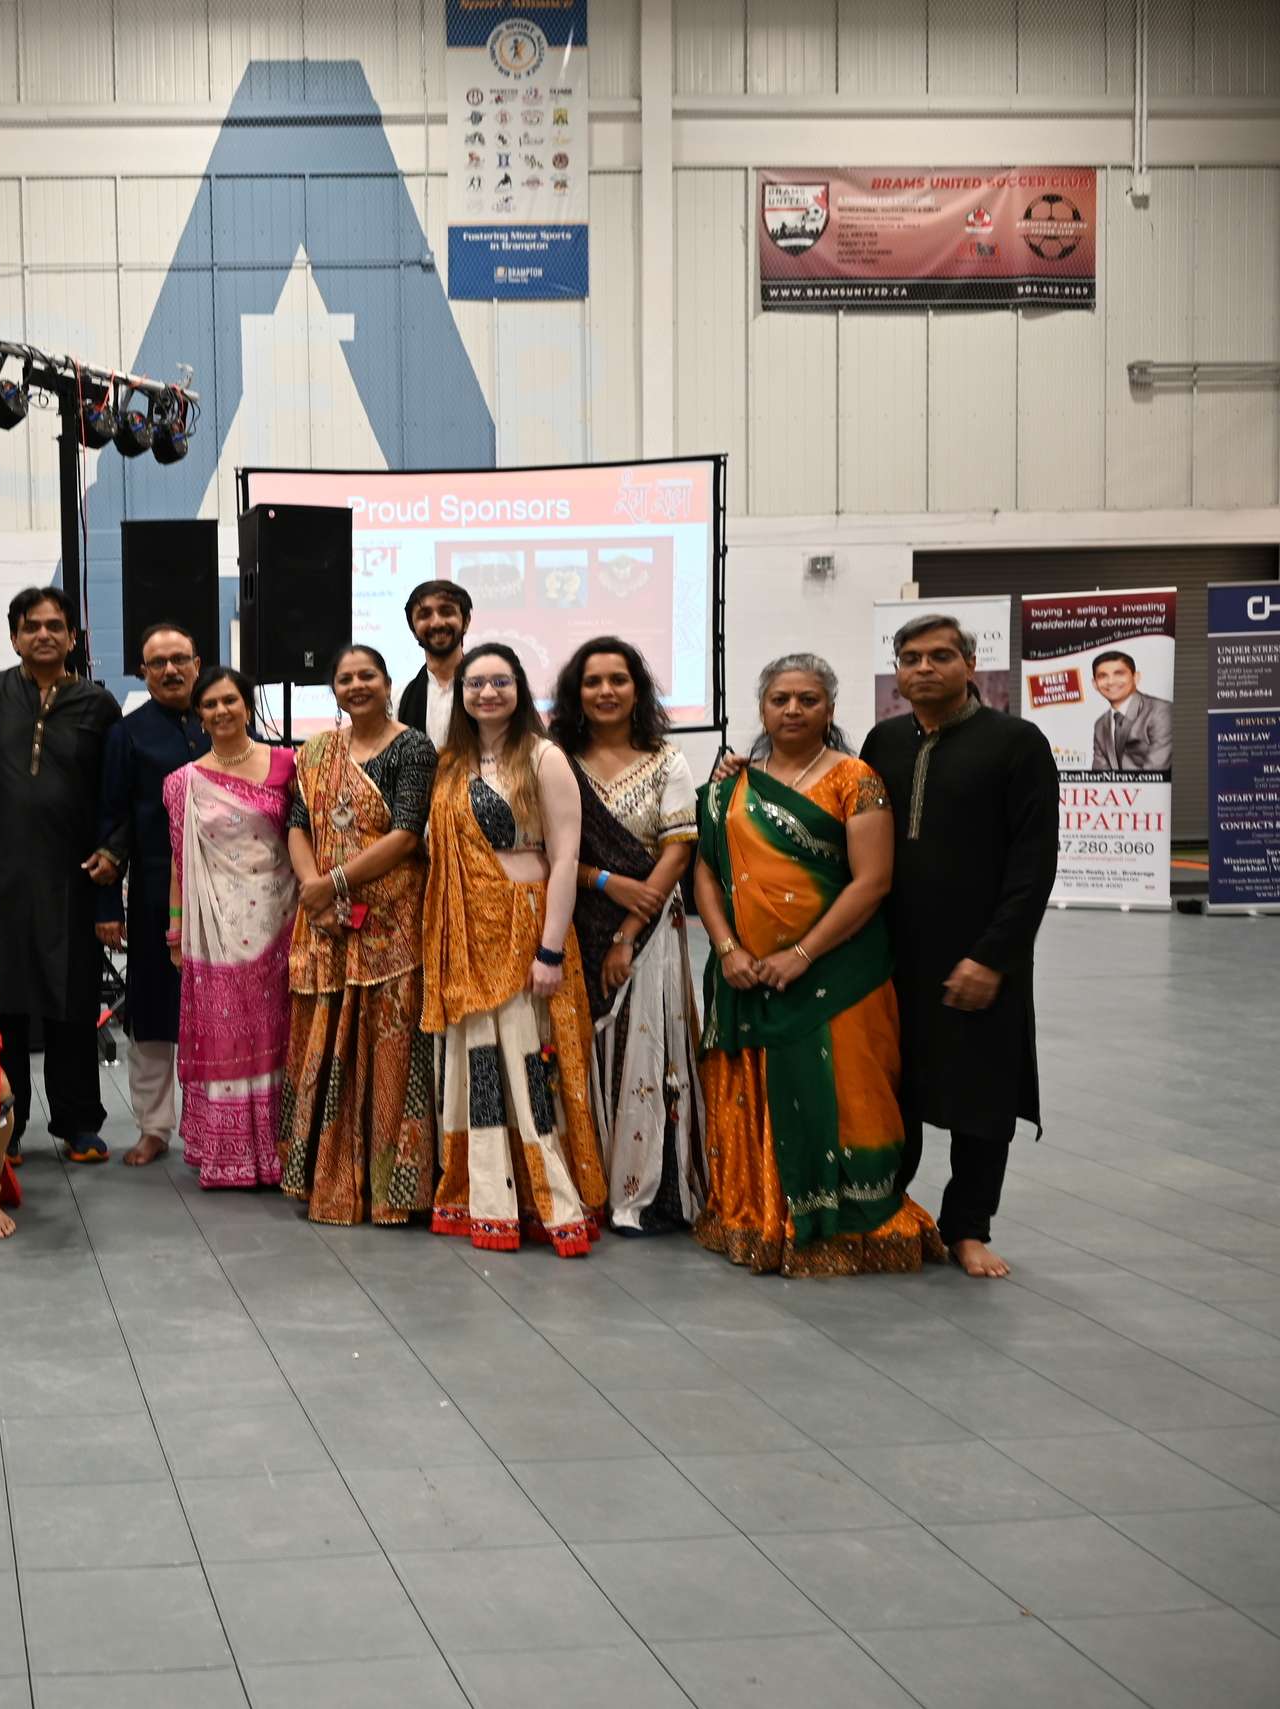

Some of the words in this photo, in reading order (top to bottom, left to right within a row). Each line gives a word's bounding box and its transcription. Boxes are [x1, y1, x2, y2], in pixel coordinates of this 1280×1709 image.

[872, 177, 925, 190] BRAMS
[930, 176, 982, 189] UNITED
[463, 231, 508, 242] Fostering
[510, 231, 537, 240] Minor
[540, 230, 572, 242] Sports
[502, 241, 549, 252] Brampton
[346, 495, 430, 524] Proud
[440, 494, 571, 527] Sponsors
[1031, 607, 1063, 620] buying
[1077, 604, 1108, 617] selling
[1122, 602, 1166, 615] investing
[1031, 617, 1087, 630] residential
[1090, 617, 1098, 628] &
[1101, 614, 1166, 627] commercial
[1217, 645, 1250, 655] UNDER
[1217, 656, 1232, 665] OR
[1234, 654, 1280, 664] PRESSURE
[1038, 672, 1069, 687] FREE!
[1044, 684, 1066, 693] HOME
[1034, 691, 1080, 705] EVALUATION
[1217, 733, 1250, 742] FAMILY
[1251, 732, 1271, 741] LAW
[1217, 793, 1253, 803] NOTARY
[1059, 811, 1165, 832] IPATHI
[1220, 821, 1274, 831] CONTRACTS
[1058, 841, 1155, 855] 7.280.3060
